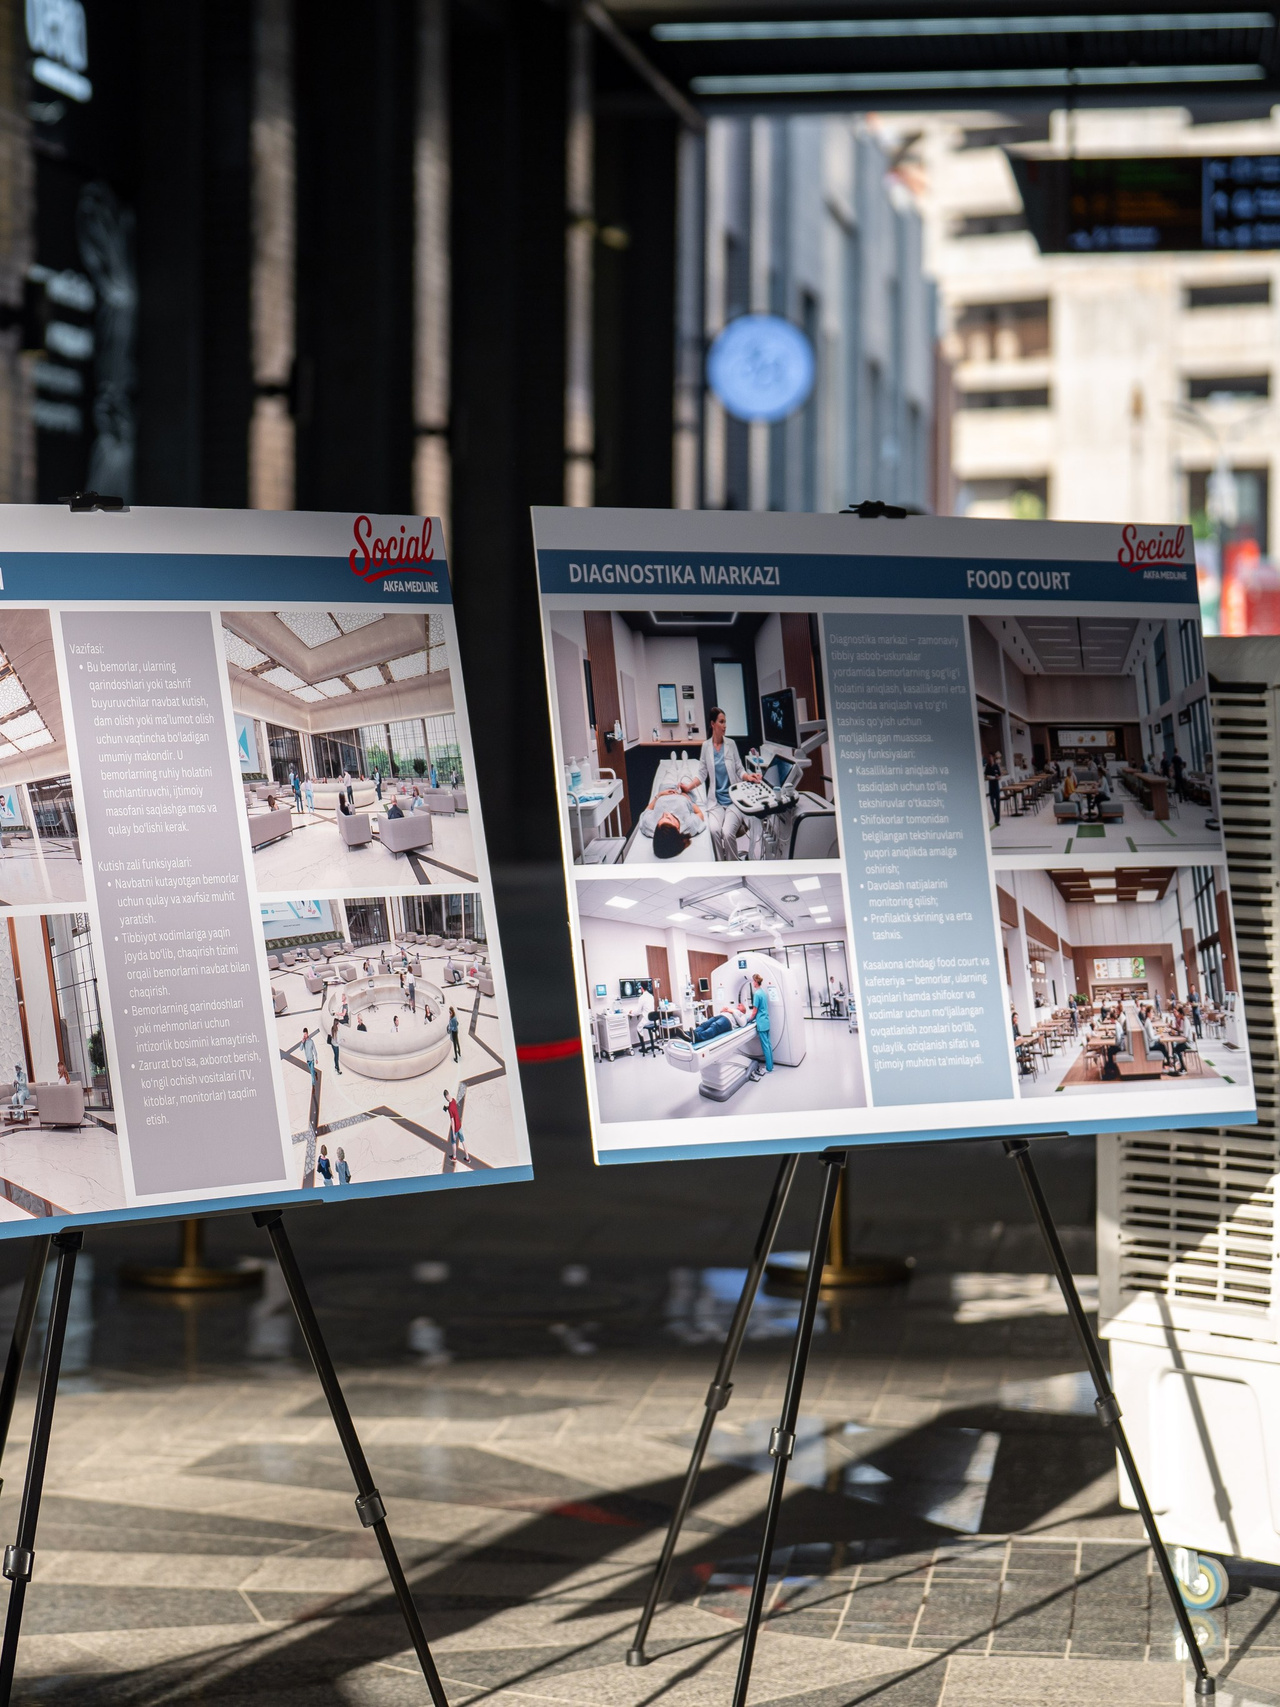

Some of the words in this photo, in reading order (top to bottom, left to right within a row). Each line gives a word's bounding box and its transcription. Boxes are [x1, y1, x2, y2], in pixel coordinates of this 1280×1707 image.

[349, 514, 434, 577] Social
[1118, 524, 1186, 568] Social
[568, 563, 695, 587] DIAGNOSTIKA
[700, 565, 781, 588] MARKAZI
[966, 570, 1012, 590] FOOD
[1017, 571, 1071, 592] COURT
[383, 580, 405, 592] AKFA
[405, 580, 439, 593] MEDLINE
[69, 642, 105, 654] Vazifasi:
[86, 660, 99, 672] Bu
[99, 660, 142, 674] bemorlar,
[141, 659, 177, 675] ularning
[88, 678, 145, 693] qarindoshlari
[145, 678, 164, 693] yoki
[164, 677, 192, 689] tashrif
[90, 696, 150, 711] buyuruvchilar
[151, 695, 181, 707] navbat
[180, 695, 209, 708] kutish,
[93, 714, 113, 727] dam
[113, 714, 135, 726] olish
[135, 713, 154, 728] yoki
[194, 712, 215, 724] olish
[95, 732, 123, 745] uchun
[123, 731, 167, 746] vaqtincha
[97, 750, 133, 765] umumiy
[133, 749, 176, 761] makondir.
[176, 749, 184, 761] U
[99, 767, 158, 782] bemorlarning
[158, 766, 180, 781] ruhiy
[180, 765, 213, 778] holatini
[102, 784, 172, 799] tinchlantiruvchi,
[172, 783, 204, 799] ijtimoiy
[104, 803, 145, 817] masofani
[145, 802, 188, 817] saqlashga
[187, 803, 206, 814] mos
[206, 803, 218, 813] va
[859, 813, 904, 825] Shifokorlar
[905, 813, 950, 824] tomonidan
[107, 822, 132, 838] qulay
[164, 820, 190, 833] kerak.
[97, 859, 125, 872] Kutish
[125, 858, 141, 871] zali
[141, 855, 192, 872] funksiyalari:
[864, 863, 900, 875] oshirish;
[114, 876, 154, 889] Navbatni
[154, 875, 202, 889] kutayotgan
[201, 872, 239, 885] bemorlar
[866, 879, 905, 891] Davolash
[905, 877, 949, 892] natijalarini
[116, 895, 145, 908] uchun
[145, 893, 169, 908] qulay
[169, 895, 181, 904] va
[181, 891, 211, 904] xavfsiz
[210, 889, 236, 902] muhit
[868, 896, 914, 909] monitoring
[914, 895, 939, 908] qilish;
[118, 912, 157, 929] yaratish.
[870, 912, 912, 924] Profilaktik
[912, 911, 945, 925] skrining
[944, 912, 956, 922] va
[955, 911, 973, 921] erta
[121, 931, 158, 946] Tibbiyot
[158, 927, 207, 942] xodimlariga
[207, 926, 231, 941] yaqin
[871, 928, 903, 941] tashxis.
[123, 949, 149, 965] joyda
[176, 945, 215, 960] chaqirish
[215, 943, 239, 956] tizimi
[126, 966, 152, 982] orqali
[152, 963, 199, 978] bemorlarni
[199, 962, 230, 975] navbat
[229, 961, 251, 973] bilan
[862, 959, 904, 970] Kasalxona
[903, 956, 936, 971] ichidagi
[935, 955, 956, 968] food
[956, 956, 979, 967] court
[979, 957, 990, 966] va
[864, 975, 906, 988] kafeteriya
[914, 973, 954, 985] bemorlar,
[954, 971, 988, 985] ularning
[128, 984, 171, 1000] chaqirish.
[866, 991, 902, 1006] yaqinlari
[902, 990, 931, 1002] hamda
[931, 989, 964, 1001] shifokor
[964, 990, 976, 999] va
[130, 1001, 189, 1017] Bemorlarning
[189, 996, 244, 1014] qarindoshlari
[868, 1008, 904, 1020] xodimlar
[904, 1007, 931, 1019] uchun
[133, 1021, 152, 1038] yoki
[152, 1017, 203, 1033] mehmonlari
[203, 1016, 231, 1029] uchun
[870, 1023, 918, 1038] ovqatlanish
[918, 1022, 951, 1035] zonalari
[135, 1038, 173, 1053] intizorlik
[173, 1035, 210, 1050] bosimini
[209, 1031, 260, 1048] kamaytirish.
[872, 1041, 906, 1055] qulaylik,
[906, 1038, 948, 1053] oziqlanish
[947, 1037, 969, 1050] sifati
[968, 1039, 981, 1048] va
[137, 1058, 170, 1071] Zarurat
[199, 1053, 233, 1066] axborot
[232, 1049, 262, 1063] berish,
[874, 1057, 905, 1072] ijtimoiy
[904, 1055, 937, 1068] muhitni
[169, 1073, 198, 1087] ochish
[197, 1069, 237, 1084] vositalari
[237, 1068, 255, 1082] (TV,
[142, 1093, 179, 1107] kitoblar,
[179, 1088, 227, 1104] monitorlar)
[226, 1086, 257, 1101] taqdim
[145, 1112, 170, 1126] etish.
